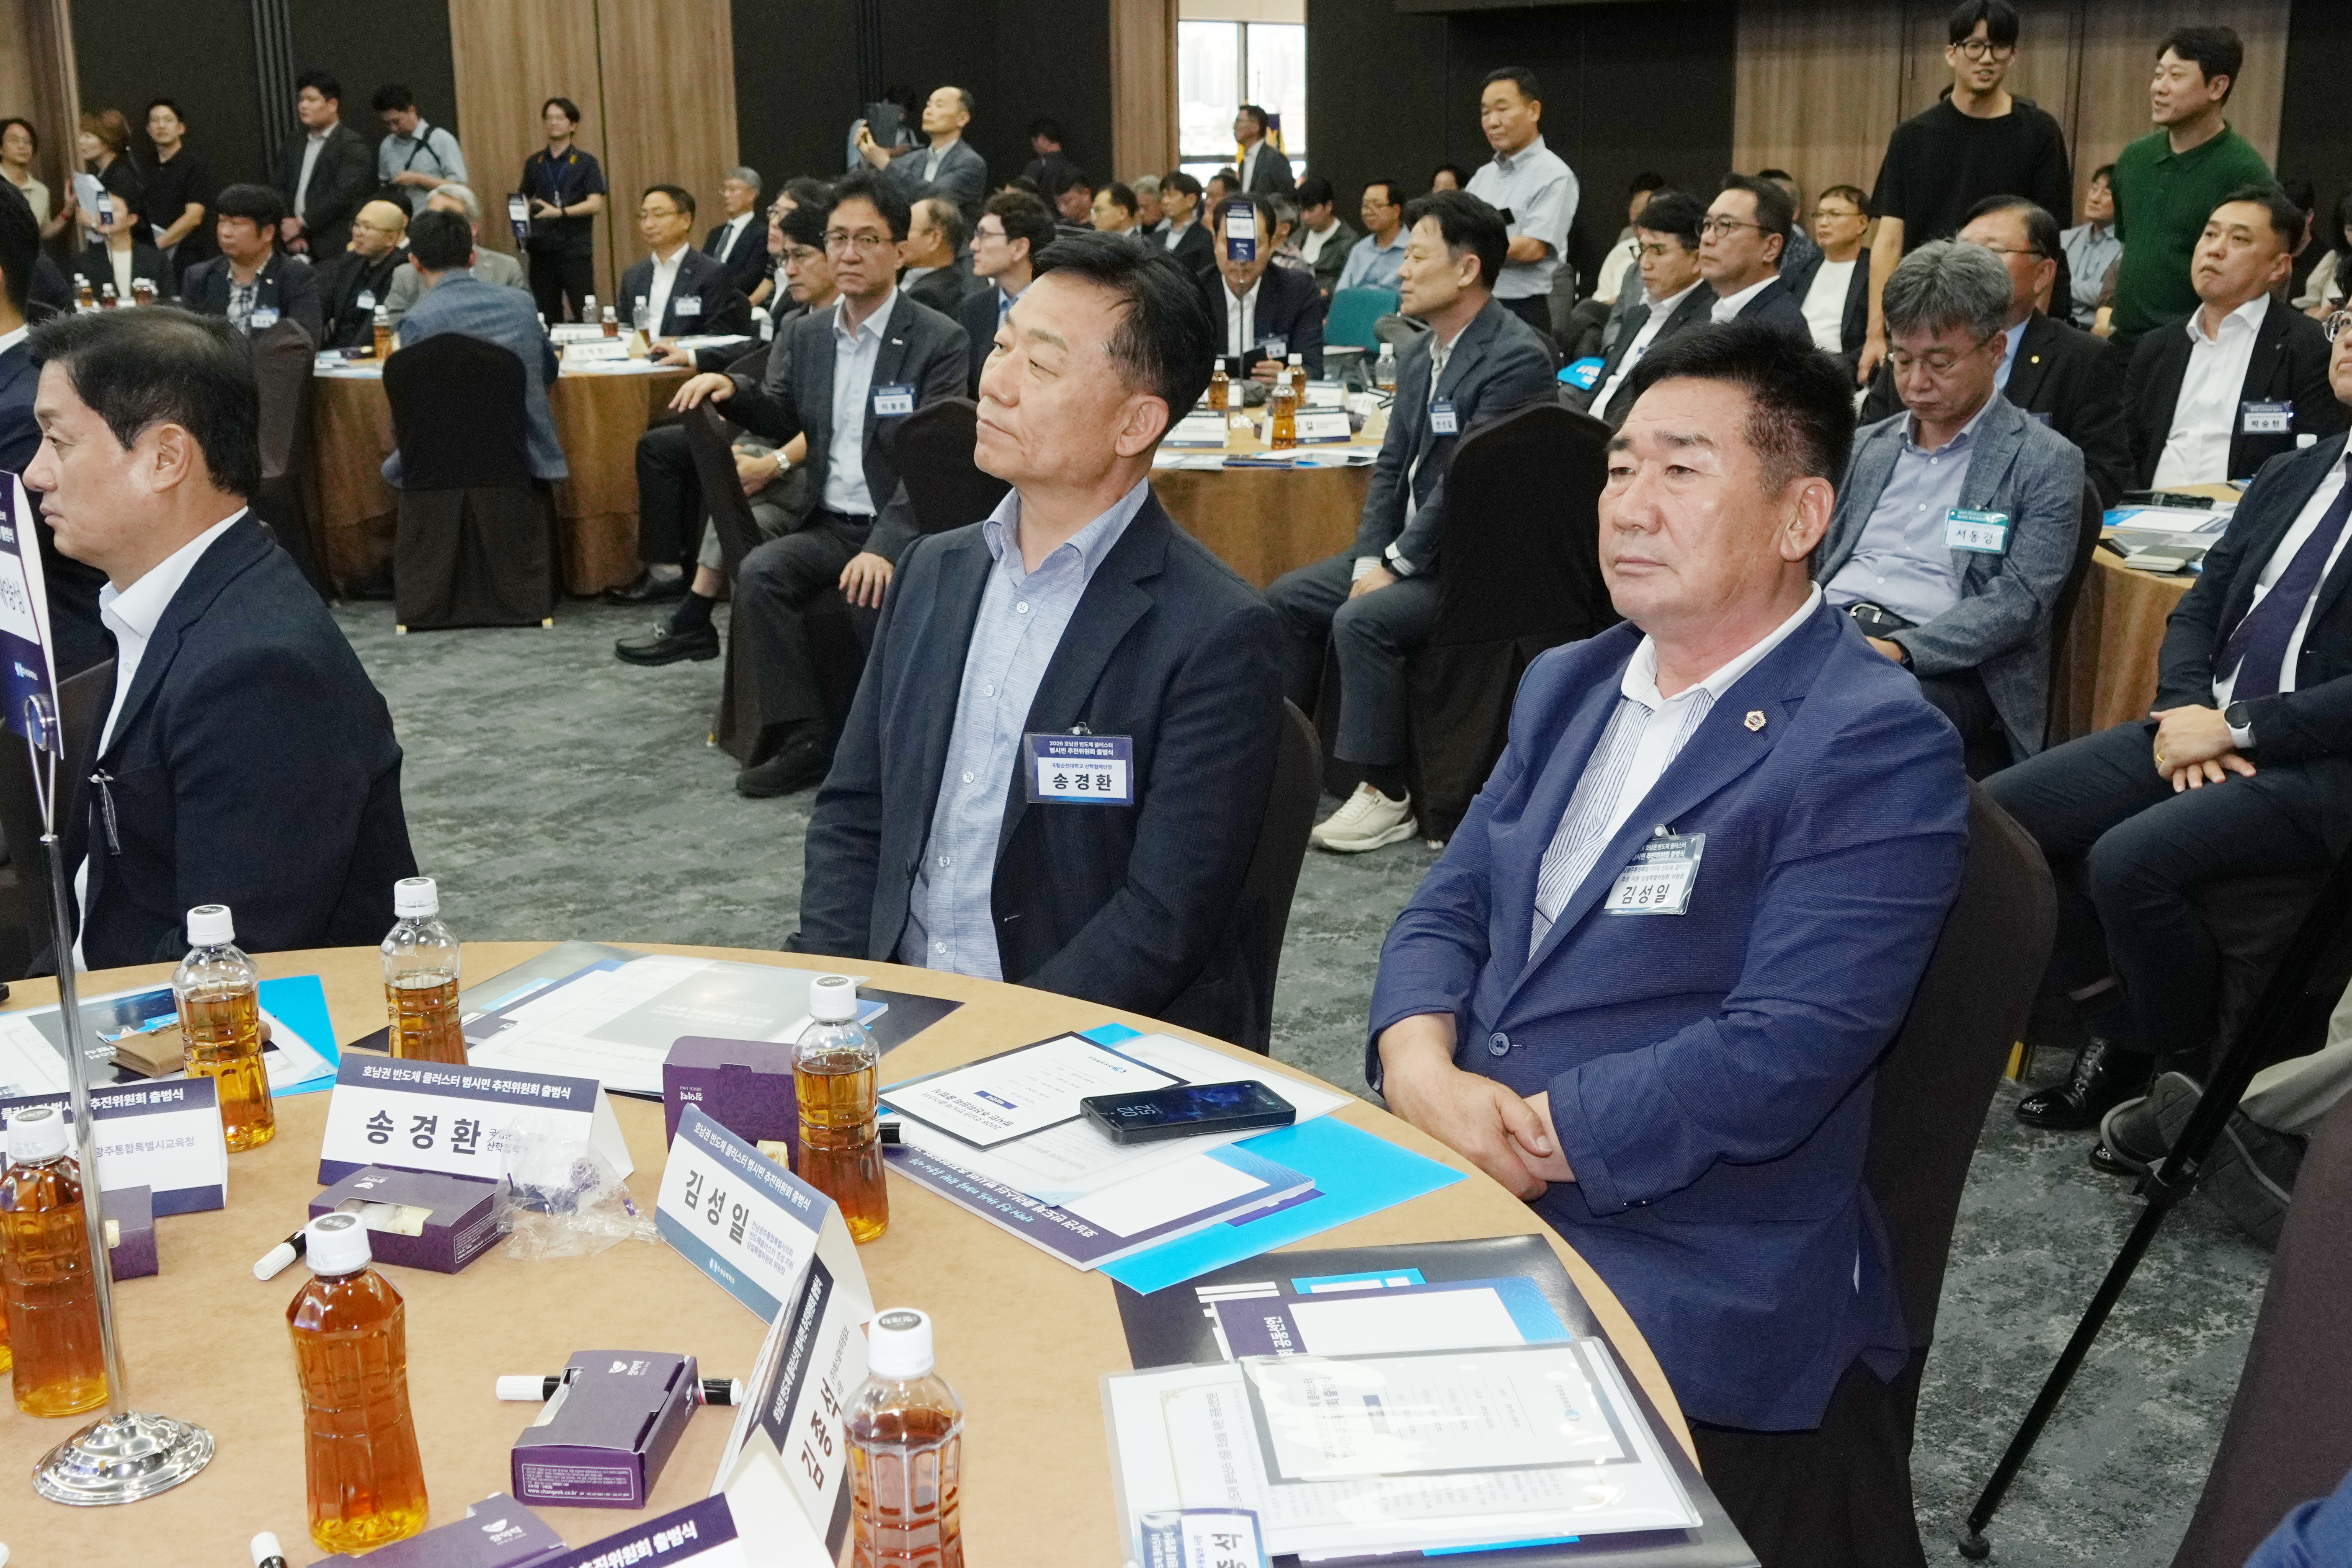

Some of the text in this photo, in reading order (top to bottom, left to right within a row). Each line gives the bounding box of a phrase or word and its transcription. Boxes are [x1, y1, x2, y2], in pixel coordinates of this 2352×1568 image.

[1053, 773, 1112, 791] 송경환
[1633, 853, 1646, 861] 시민
[1646, 851, 1670, 859] 추진위원회
[1622, 884, 1670, 904] 김성일
[362, 1065, 571, 1099] 호남권 반도체 클러스터 범시민 추진위원회 출범식
[90, 1087, 184, 1110] 추진위원회 출범식
[952, 1099, 990, 1117] 추진위원회
[962, 1111, 984, 1122] 호남권
[1117, 1106, 1138, 1117] 02
[1134, 1105, 1155, 1115] 52
[982, 1120, 1001, 1130] 2026
[987, 1115, 1014, 1127] 범시민
[366, 1109, 481, 1155] 송경환
[74, 1136, 195, 1160] 전광주통합특별시교육청
[694, 1122, 812, 1212] 호남권 반도체 클러스터 범시민 추진위원회 출범식
[993, 1184, 1039, 1210] 클러스터
[685, 1170, 750, 1246] 김성일
[1031, 1203, 1068, 1224] 반도체
[752, 1221, 794, 1257] 전남광주통합특별시의회
[1060, 1219, 1098, 1238] 호남권
[747, 1241, 786, 1276] 상설특별위원회 위원장
[749, 1231, 794, 1270] 반도체클러스터 조성 지원
[1264, 1316, 1292, 1348] 공동서약
[773, 1274, 823, 1425] 호남권 반도체 클러스터 범시민 추진위원회 출범식
[837, 1380, 844, 1397] 사장
[1302, 1378, 1320, 1400] 클러스터
[1206, 1392, 1222, 1418] 공동선언문
[1212, 1420, 1225, 1431] 위한
[1215, 1432, 1228, 1448] 조성을
[1219, 1450, 1232, 1461] 성공
[653, 1519, 698, 1553] 출범식
